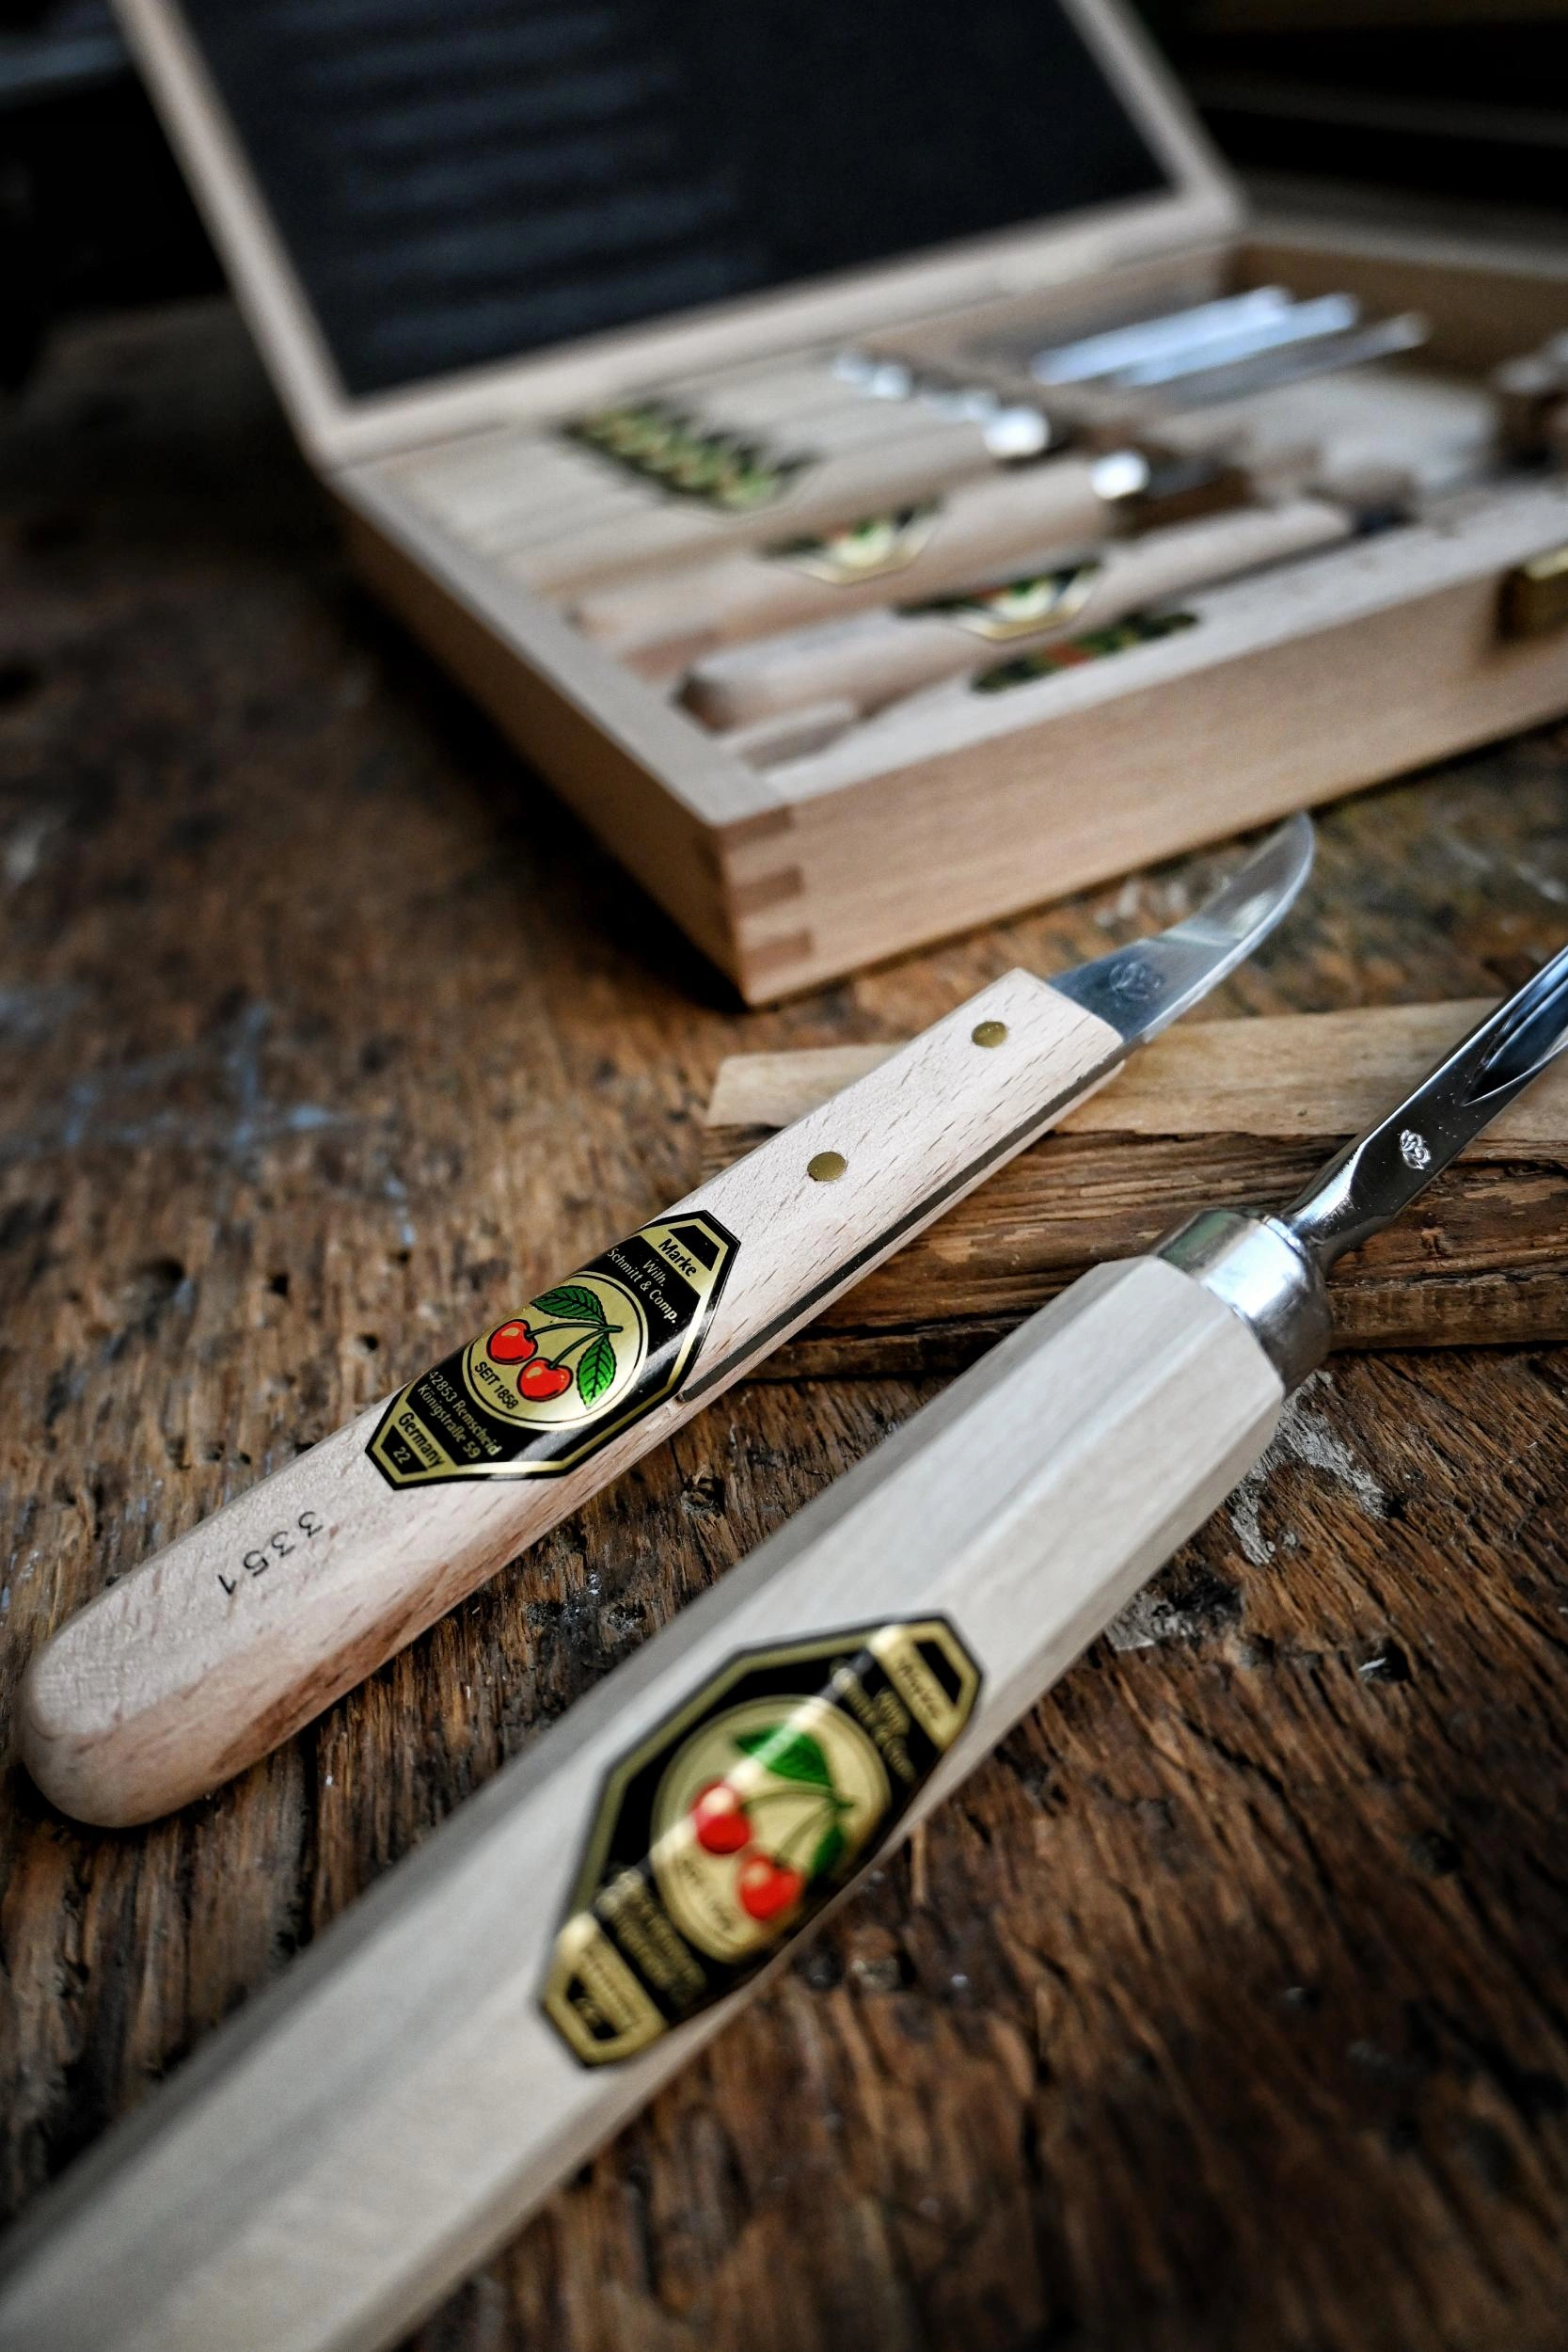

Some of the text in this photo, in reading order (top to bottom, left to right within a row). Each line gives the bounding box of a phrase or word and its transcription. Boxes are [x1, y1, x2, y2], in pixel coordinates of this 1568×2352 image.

[642, 1259, 667, 1287] Wilh.
[658, 1238, 697, 1277] Marke
[607, 1248, 677, 1324] Schmitt & Comp.
[417, 1383, 467, 1442] Königstraße
[474, 1361, 519, 1409] SEIT 1858
[398, 1412, 446, 1468] Germany
[429, 1371, 503, 1456] 42853 Remscheid
[393, 1446, 411, 1465] 22
[217, 1511, 324, 1596] 3351
